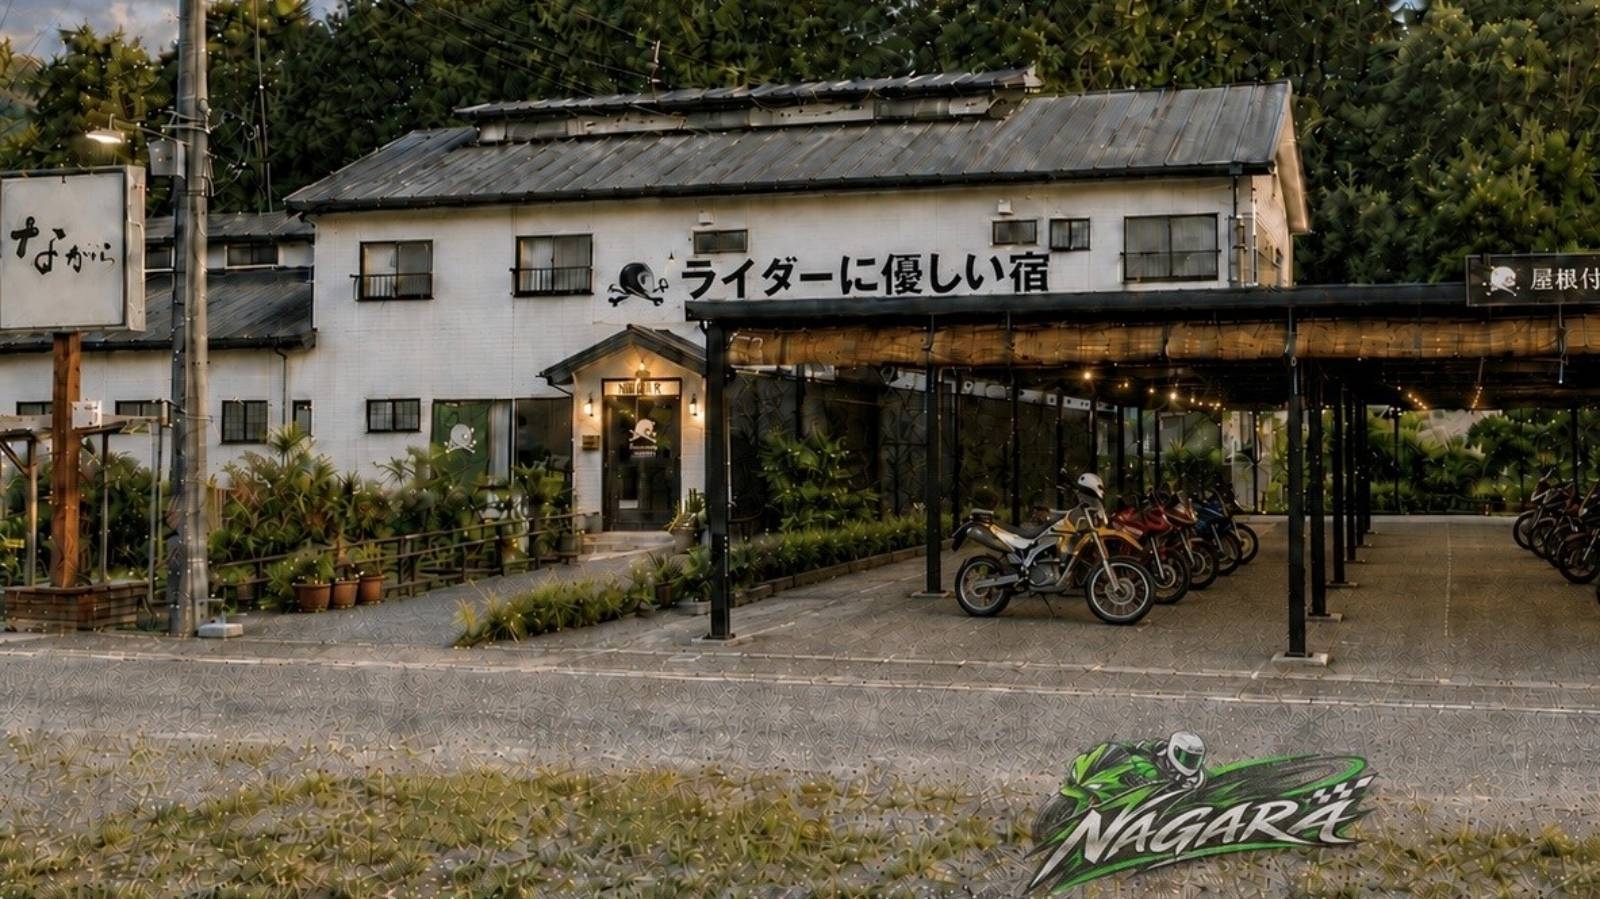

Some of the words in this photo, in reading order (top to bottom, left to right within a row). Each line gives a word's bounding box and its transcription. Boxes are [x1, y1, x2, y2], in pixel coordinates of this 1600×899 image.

[681, 251, 1050, 300] ライダーに優しい宿
[1530, 267, 1600, 291] 屋根付
